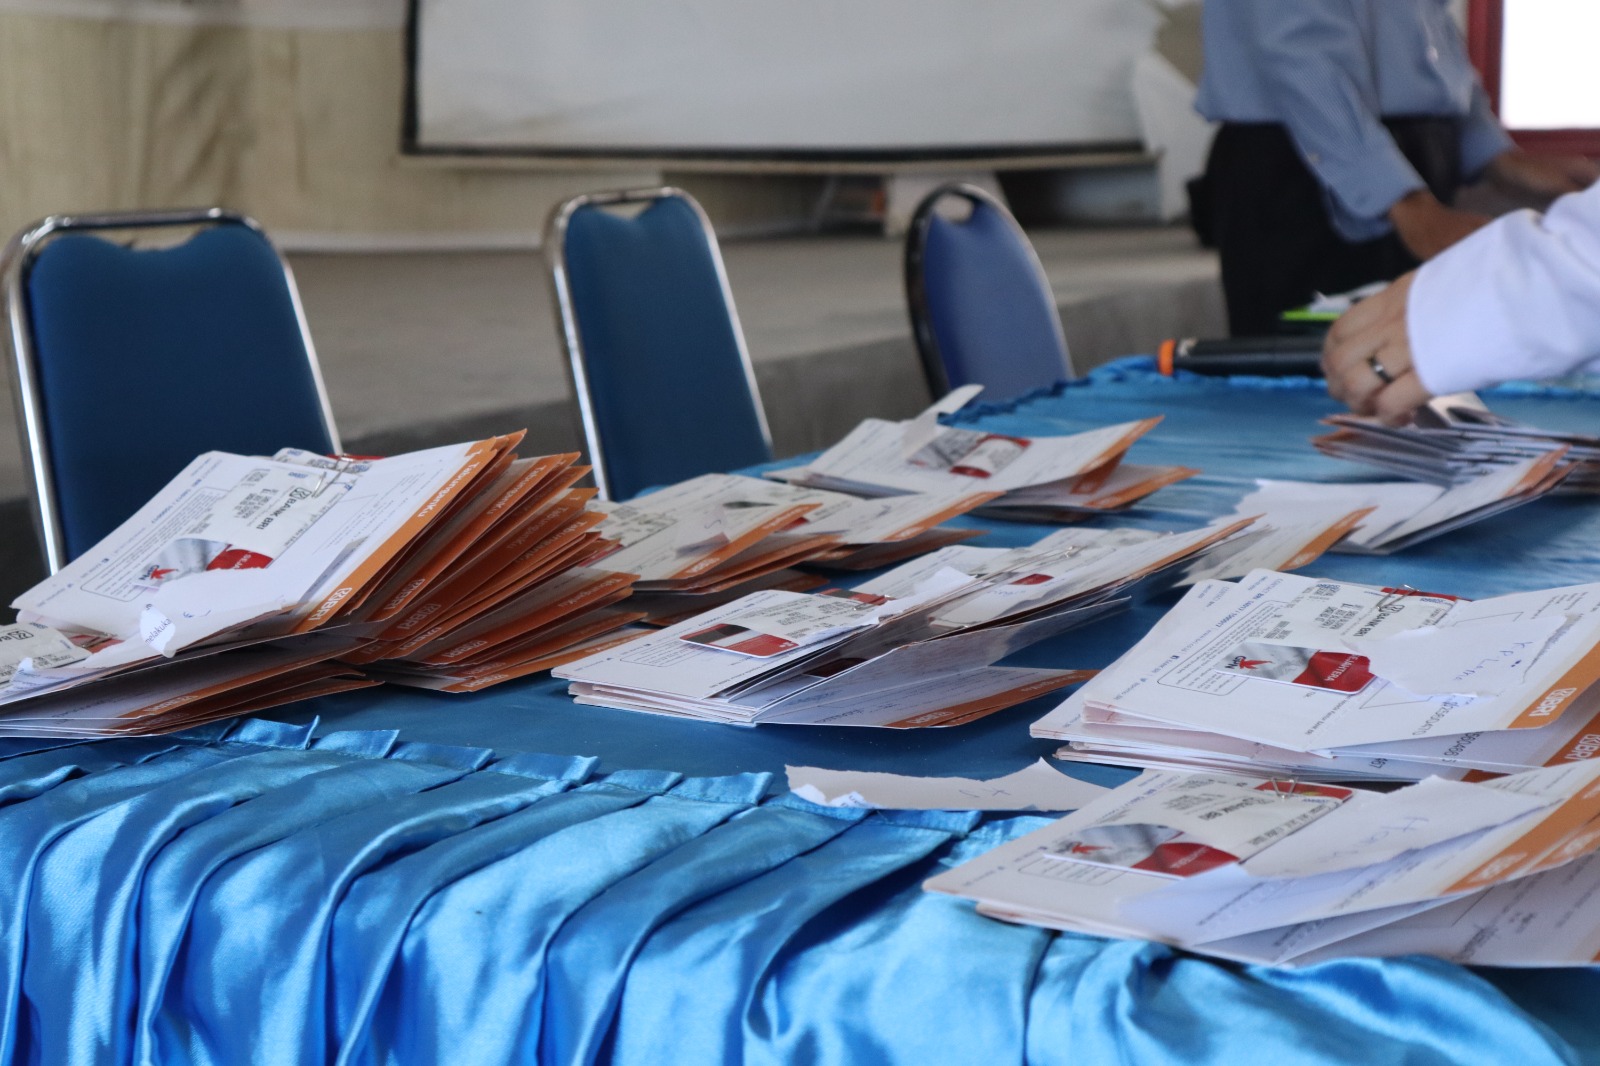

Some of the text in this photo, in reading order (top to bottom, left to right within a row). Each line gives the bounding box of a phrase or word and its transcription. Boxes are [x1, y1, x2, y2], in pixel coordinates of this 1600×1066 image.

[417, 461, 481, 518] TabunganKu
[486, 464, 547, 516] TabunganKu
[275, 497, 297, 518] BANK
[256, 517, 274, 531] BRI
[309, 598, 339, 622] BRI
[1366, 611, 1391, 632] BANK
[1353, 627, 1371, 638] BRI
[1225, 655, 1247, 670] GPN
[1528, 693, 1561, 718] BRI
